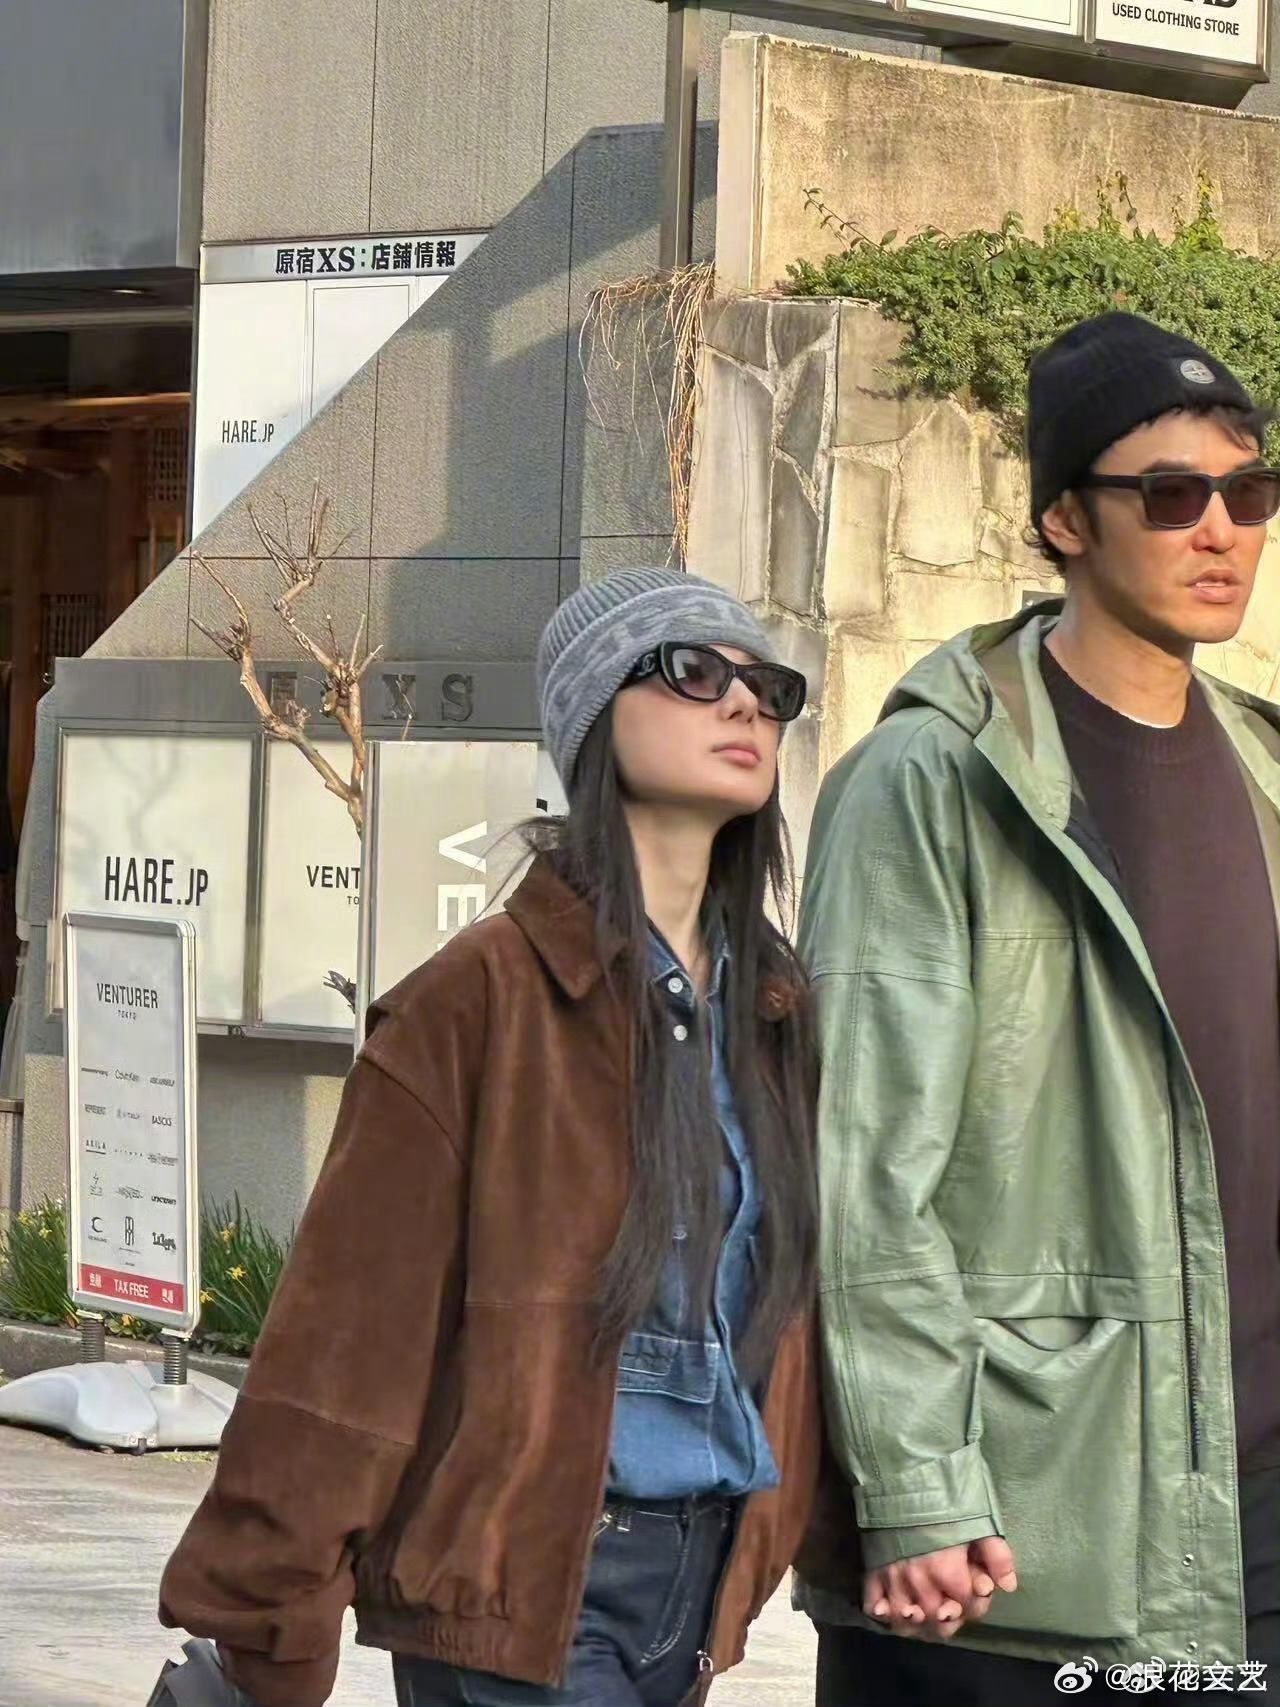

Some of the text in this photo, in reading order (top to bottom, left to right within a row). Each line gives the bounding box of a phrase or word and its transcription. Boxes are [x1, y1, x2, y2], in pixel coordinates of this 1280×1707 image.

[1112, 3, 1240, 36] USED CLOTHING STORE
[221, 420, 275, 443] HARE.JP
[104, 855, 209, 907] HARE.JP
[96, 982, 159, 1009] VENTURER
[113, 1278, 129, 1296] TAX
[128, 1281, 149, 1299] FREE
